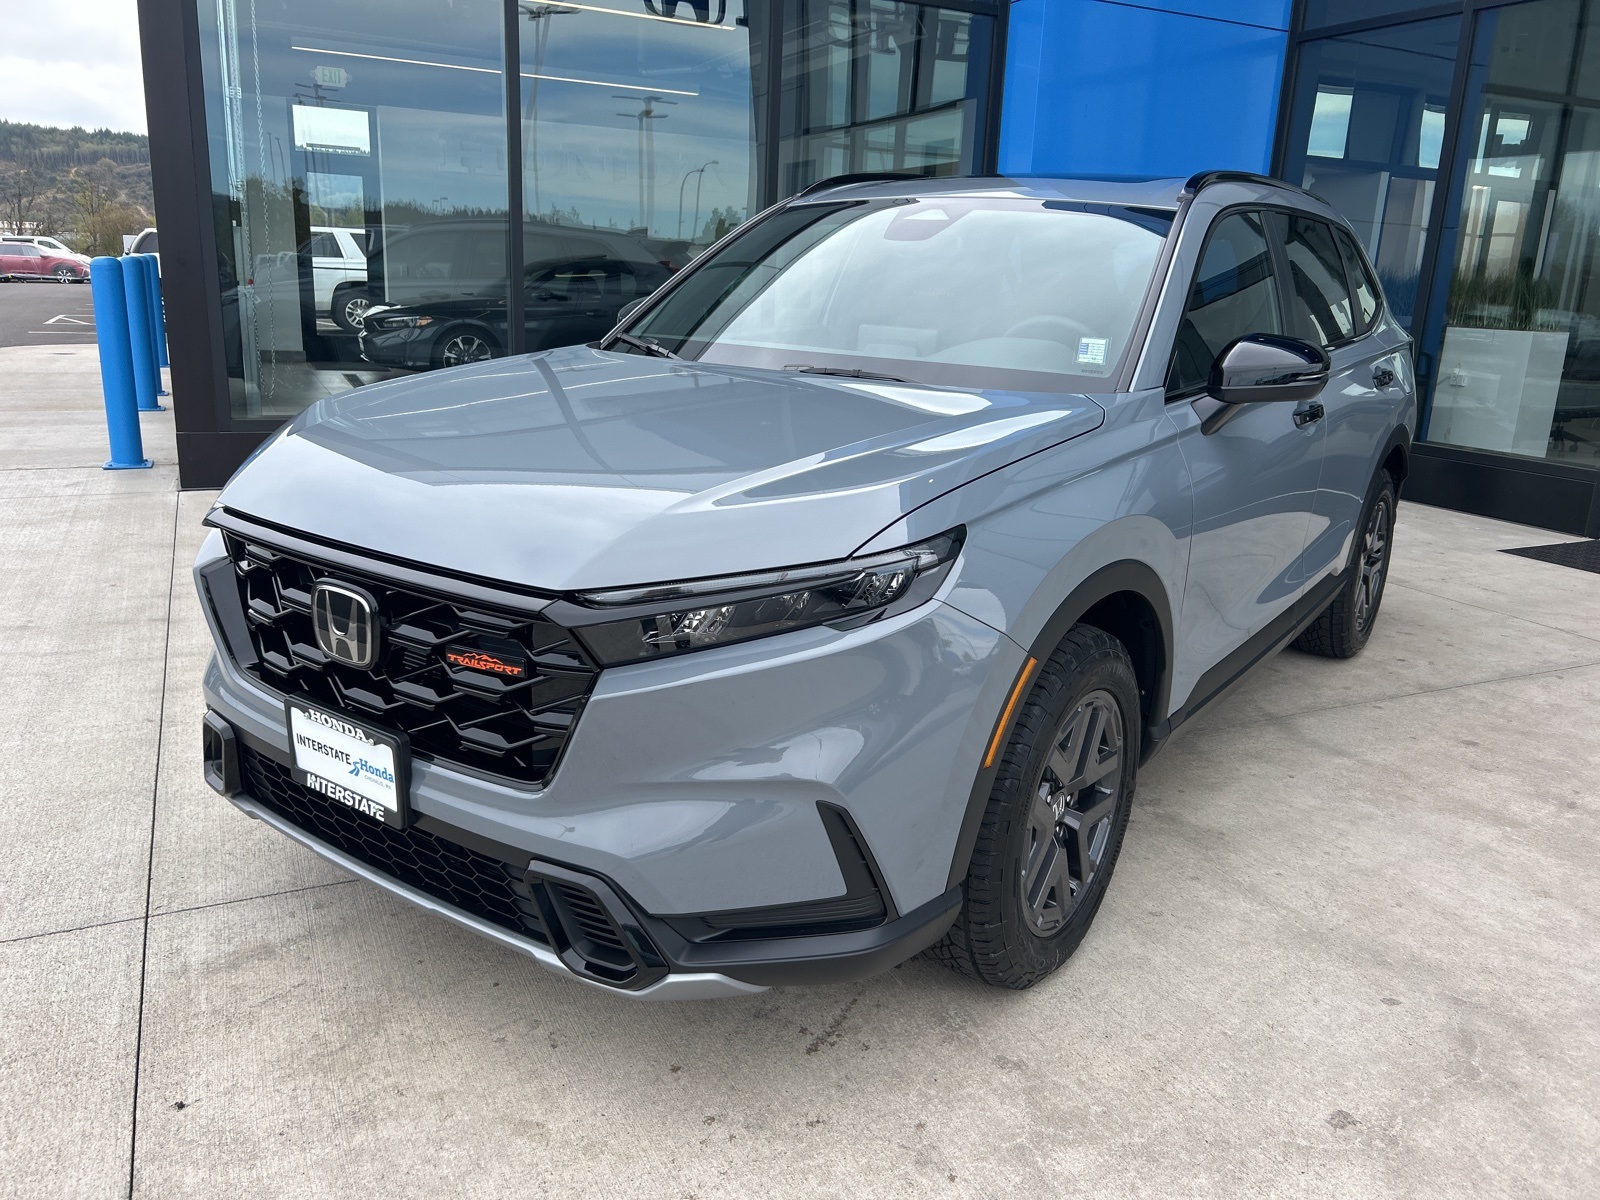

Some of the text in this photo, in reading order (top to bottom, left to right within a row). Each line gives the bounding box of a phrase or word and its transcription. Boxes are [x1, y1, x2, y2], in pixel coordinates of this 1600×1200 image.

[322, 67, 341, 84] EXIT
[447, 653, 522, 675] TRAILSPORT
[308, 709, 370, 743] HONDA
[296, 733, 394, 783] INTERSTATE Honda
[306, 773, 385, 821] INTERSTATE
